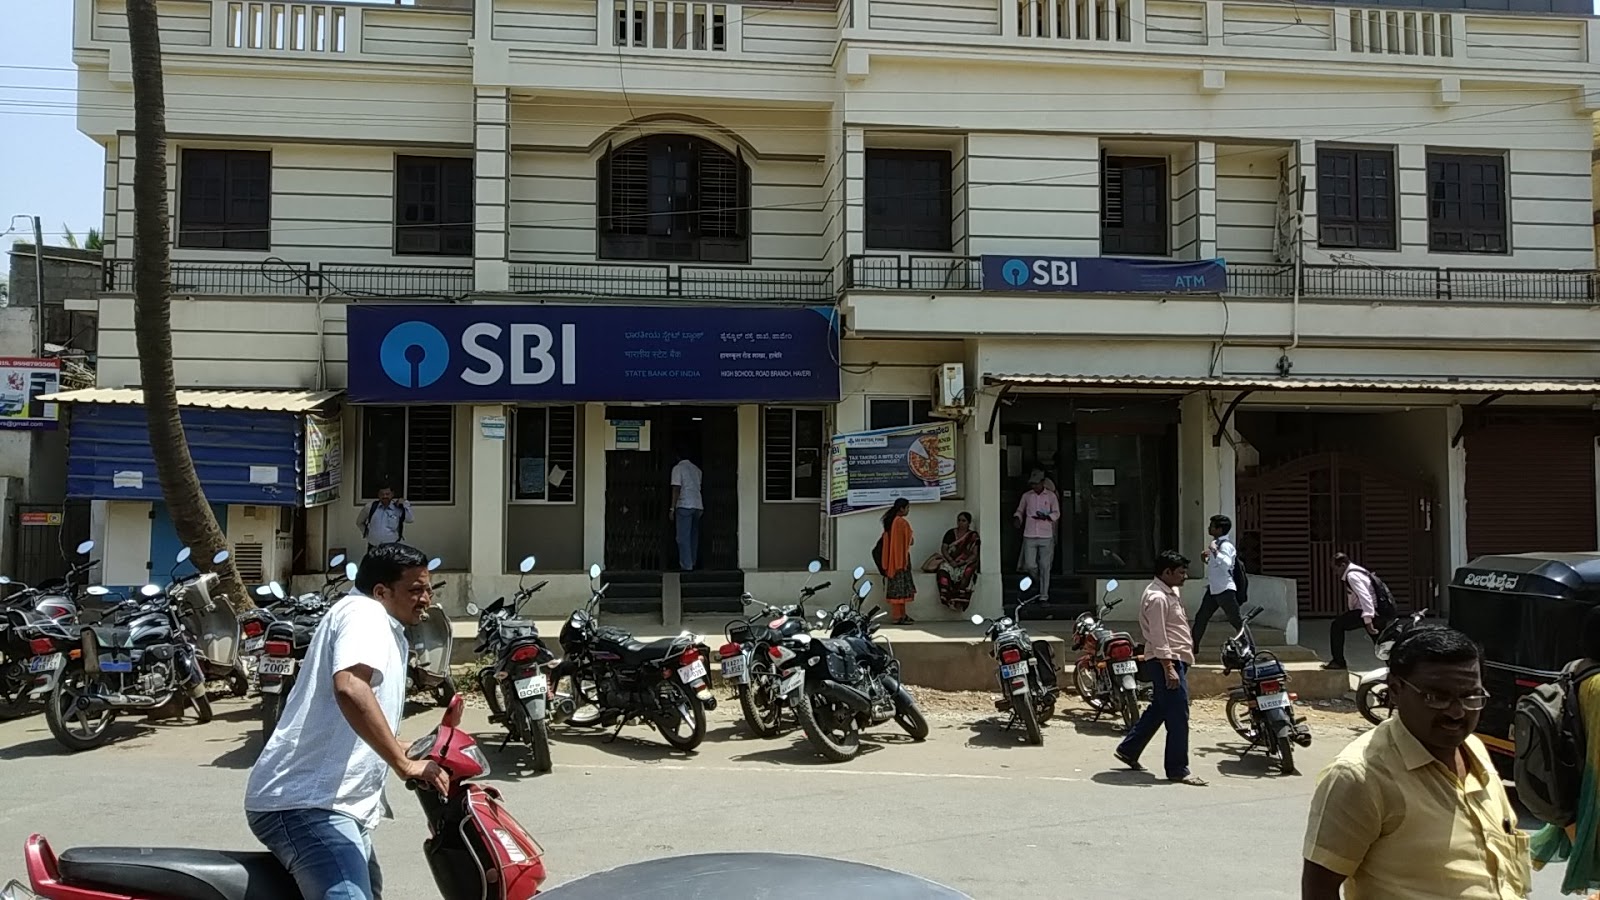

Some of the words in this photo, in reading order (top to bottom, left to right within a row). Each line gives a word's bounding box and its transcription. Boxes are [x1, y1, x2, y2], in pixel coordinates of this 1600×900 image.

[1032, 259, 1078, 286] SBI
[1174, 275, 1206, 288] ATM
[460, 322, 576, 386] SBI
[264, 664, 290, 673] 7005
